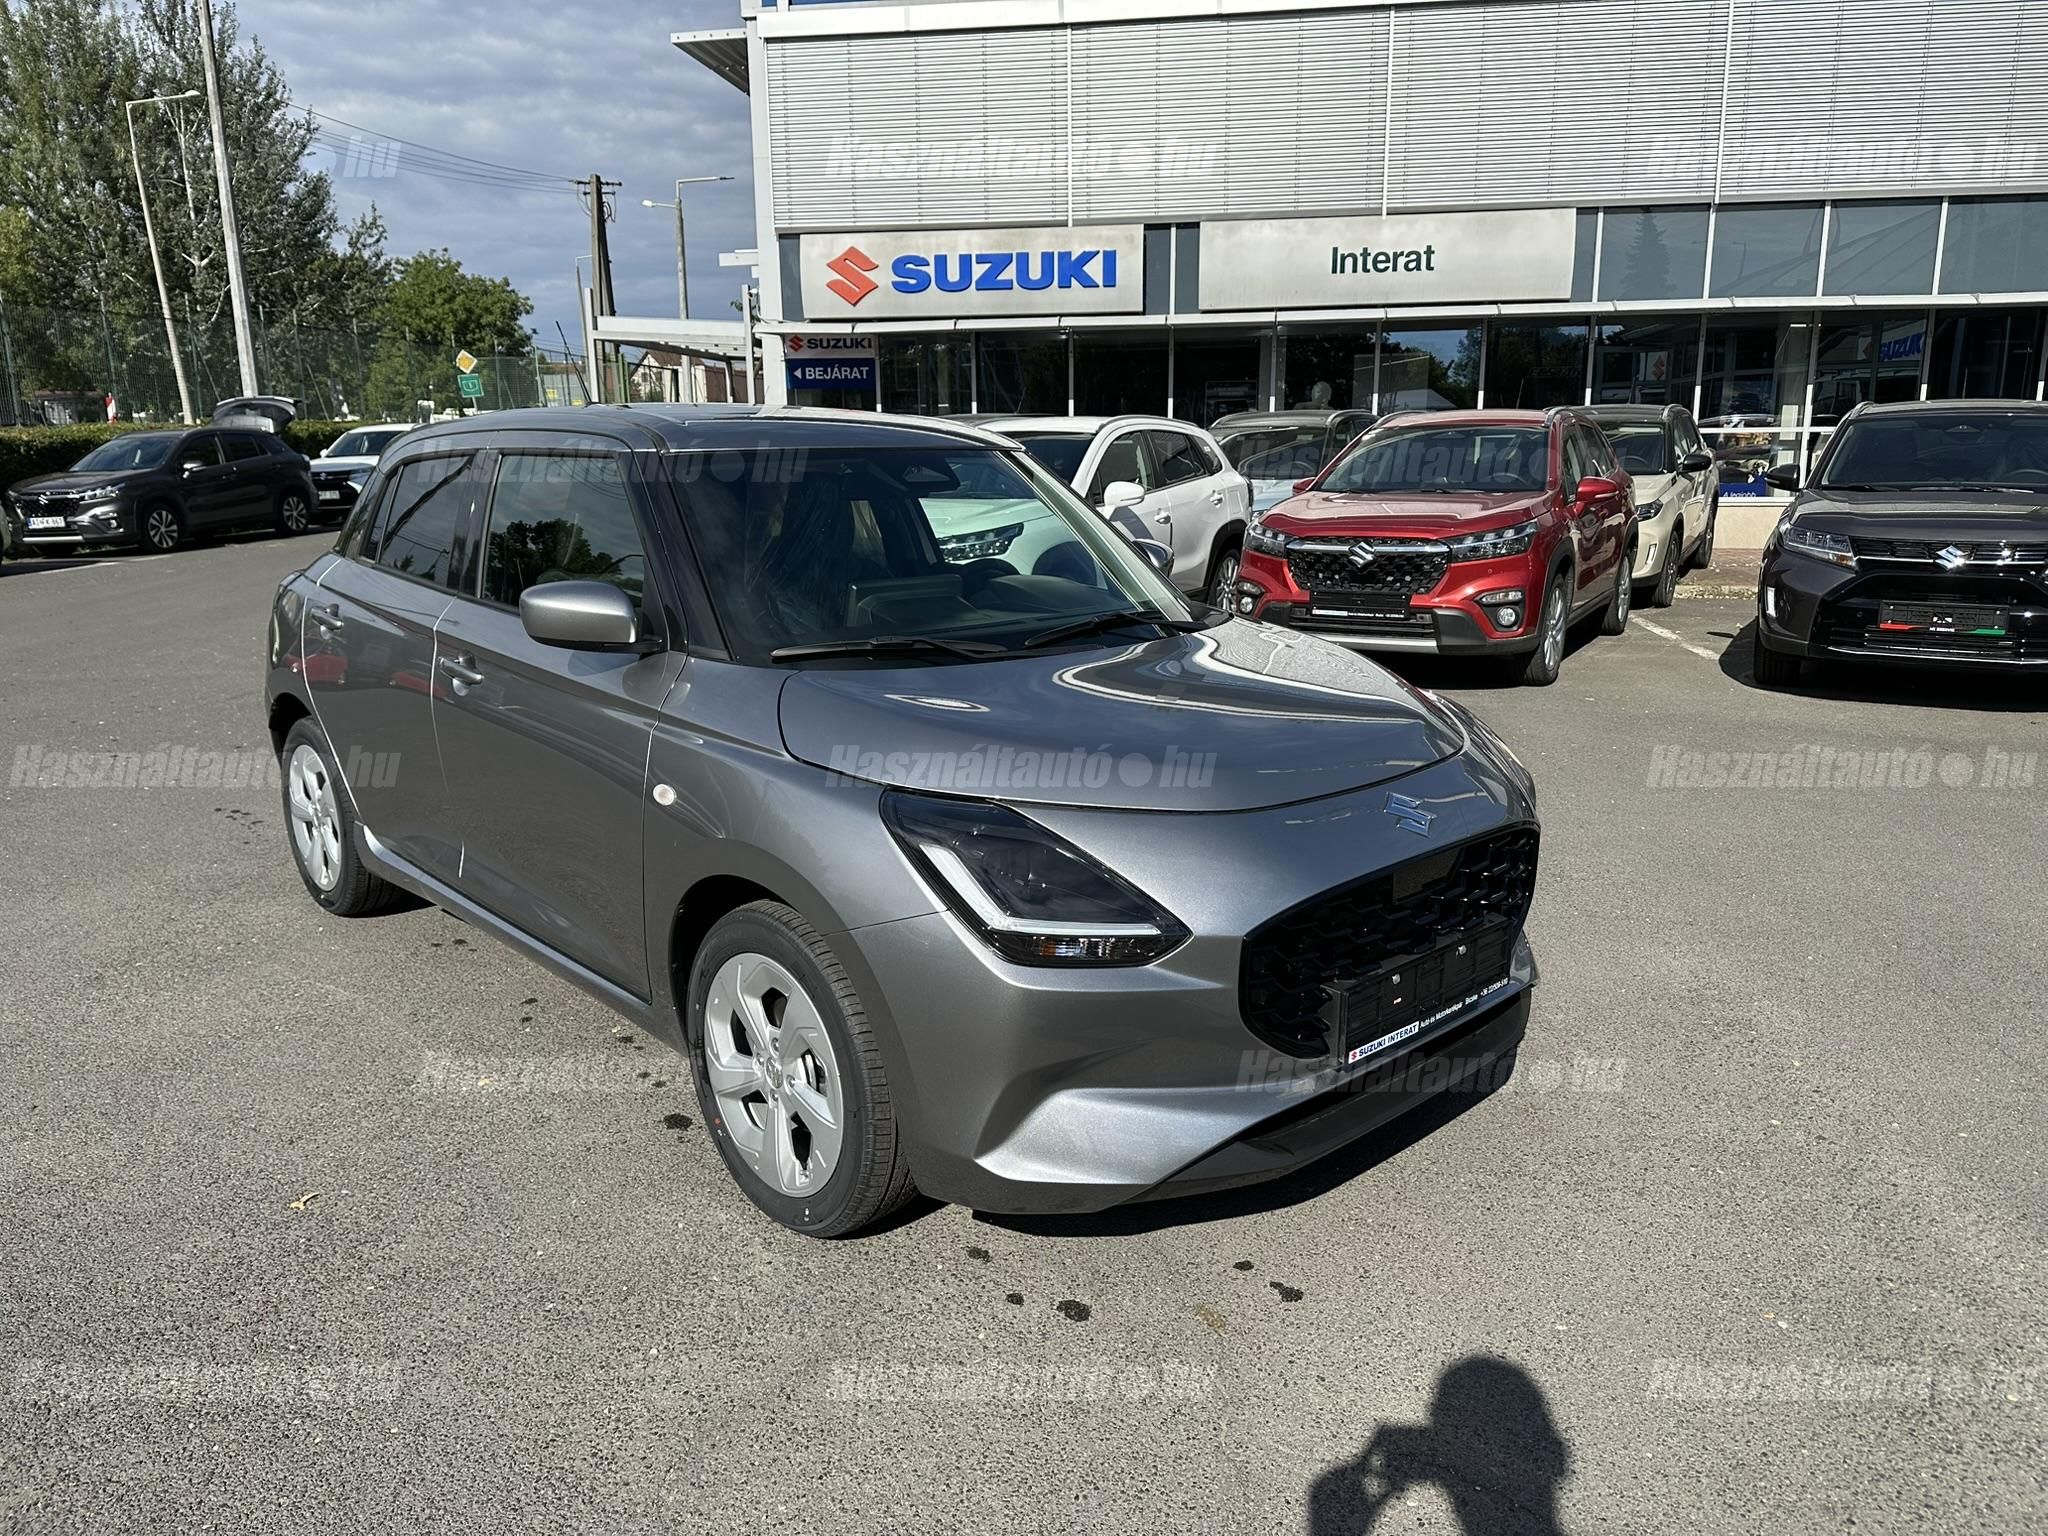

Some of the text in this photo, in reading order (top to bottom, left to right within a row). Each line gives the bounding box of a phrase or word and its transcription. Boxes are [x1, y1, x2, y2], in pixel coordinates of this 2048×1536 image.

[891, 249, 1117, 294] SUZUKI
[1331, 244, 1436, 274] Interat
[806, 337, 873, 349] SUZUKI
[805, 364, 869, 380] BEJÁRAT
[1358, 1041, 1386, 1057] SUZUKI
[1387, 1024, 1418, 1045] INTERAT
